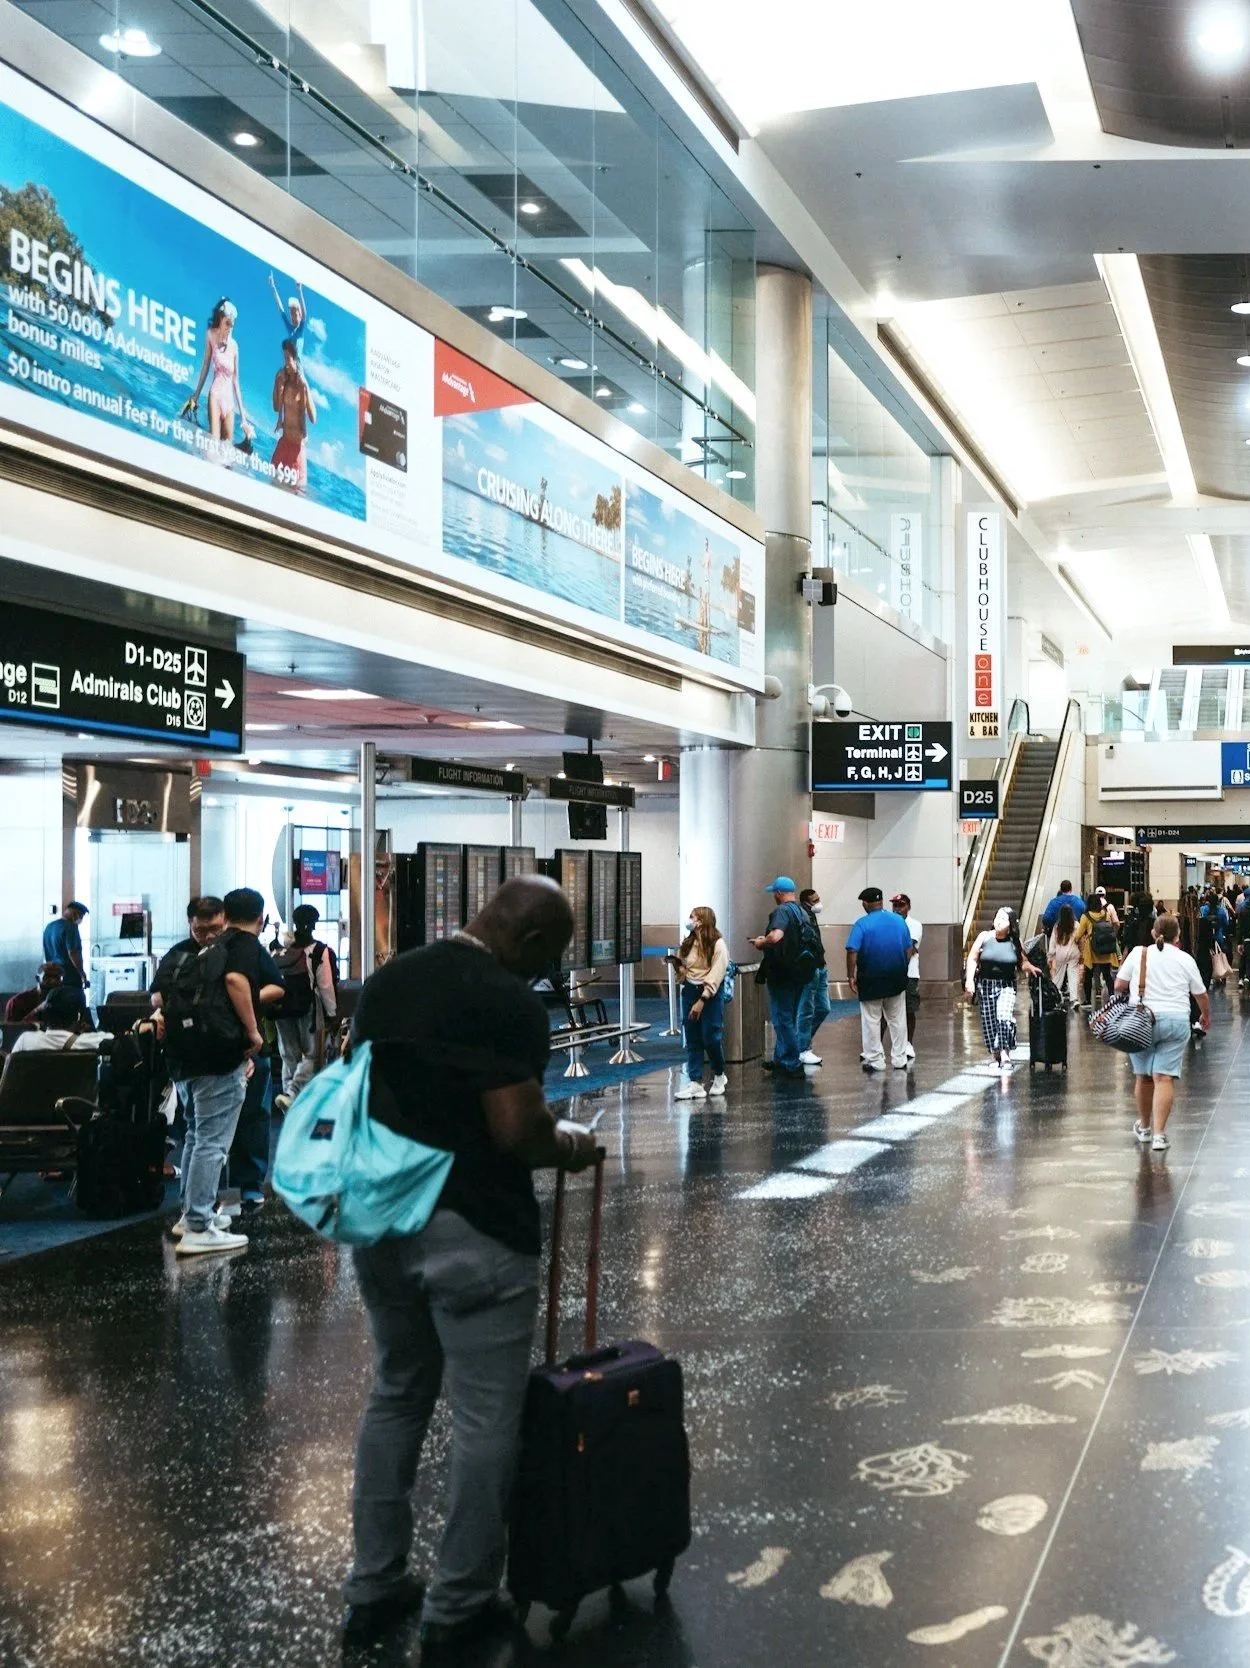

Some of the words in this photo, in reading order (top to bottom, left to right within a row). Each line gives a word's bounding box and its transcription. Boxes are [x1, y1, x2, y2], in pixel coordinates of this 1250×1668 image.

[9, 228, 122, 318] BEGINS
[128, 288, 197, 357] HERE
[8, 285, 46, 317] with
[48, 303, 101, 340] 50,000
[8, 310, 57, 352] bonus
[60, 330, 105, 372] miles.
[8, 350, 30, 381] $0
[32, 361, 71, 397] intro
[73, 380, 124, 417] annual
[125, 396, 148, 425] fee
[149, 407, 170, 435] for
[172, 418, 194, 446] the
[195, 425, 223, 458] first
[224, 439, 250, 474] year,
[250, 448, 276, 480] then
[477, 466, 540, 521] CRUISING
[541, 498, 581, 541] ALONG
[632, 544, 664, 576] BEGINS
[664, 557, 686, 590] HERE
[978, 517, 989, 651] CLUBHOUSE
[70, 670, 143, 703] Admirals
[146, 683, 181, 710] Club
[977, 657, 989, 705] one
[8, 689, 27, 704] D12
[970, 712, 998, 723] KITCHEN
[858, 725, 902, 741] EXIT
[970, 726, 975, 736] &
[983, 726, 999, 737] BAR
[845, 746, 902, 759] Terminal
[438, 767, 462, 782] FLIGHT
[463, 770, 504, 787] INFORMATION
[847, 766, 858, 780] F,
[860, 766, 875, 780] G,
[878, 766, 892, 780] H,
[894, 766, 902, 779] J
[569, 785, 587, 797] FLIGHT
[963, 791, 994, 804] D25
[818, 824, 839, 840] EXIT
[962, 822, 978, 833] EXIT
